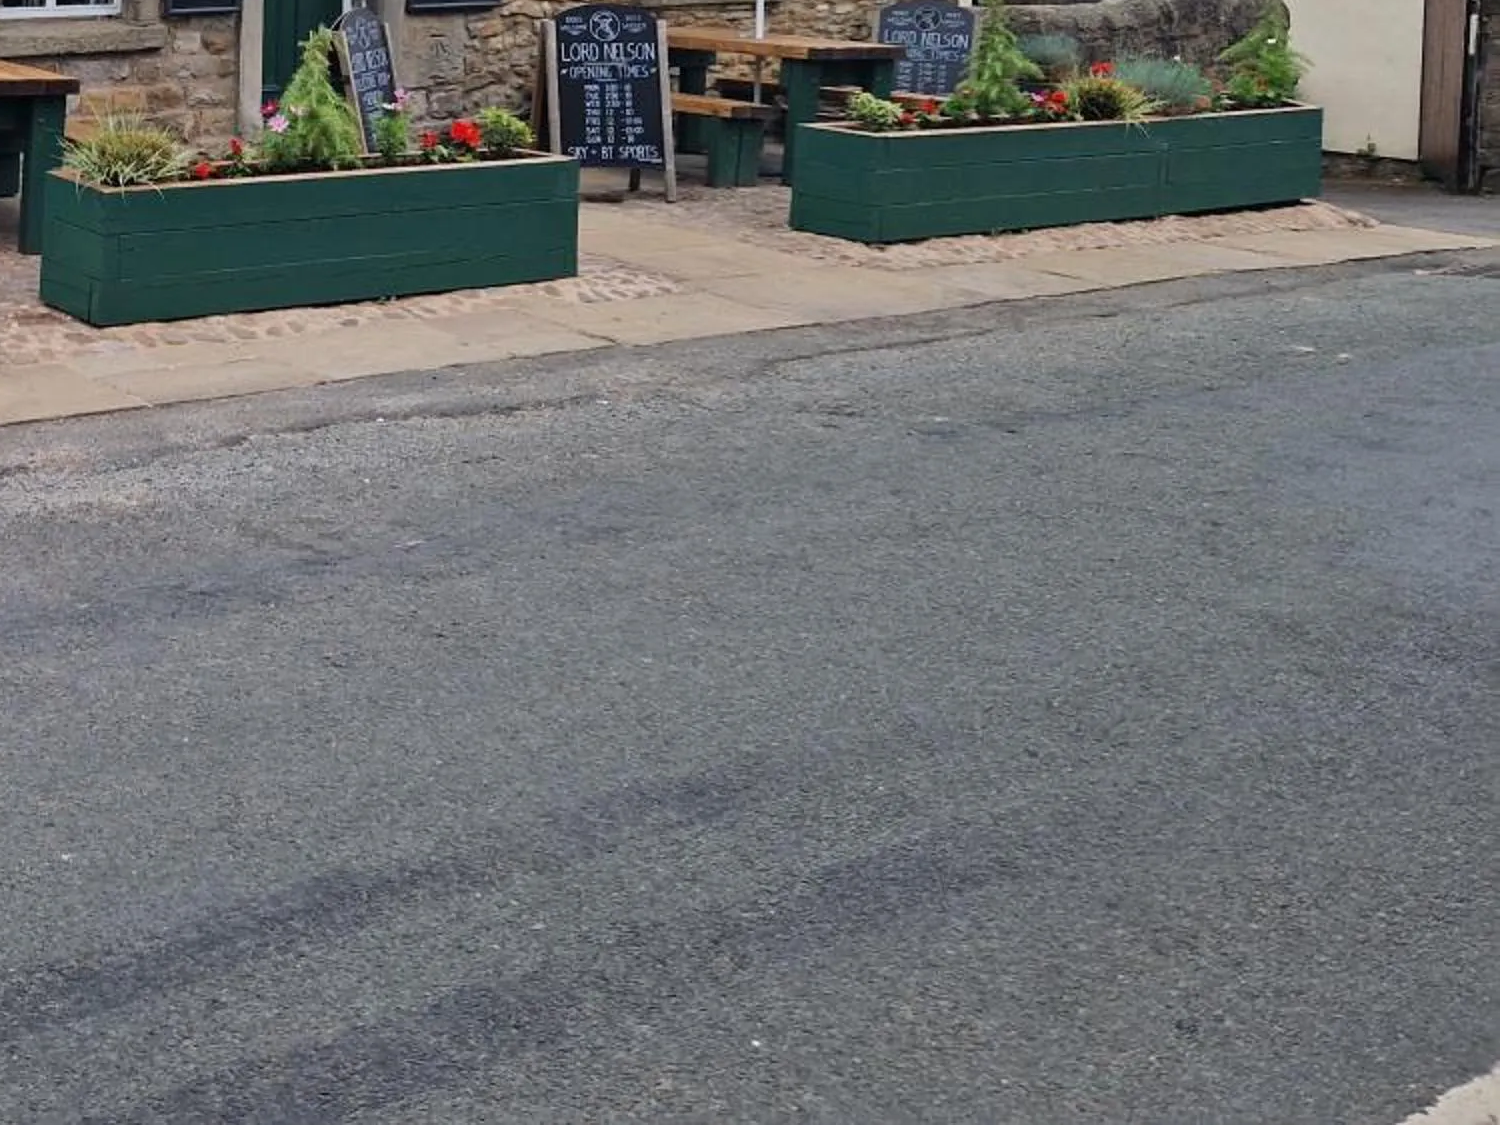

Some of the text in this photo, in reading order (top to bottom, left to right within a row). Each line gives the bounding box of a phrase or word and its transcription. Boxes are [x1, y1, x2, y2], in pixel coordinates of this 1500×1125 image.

[883, 29, 969, 50] LORD NELSON
[561, 41, 656, 63] LORD NELSON
[569, 64, 649, 80] OPENING TIMES
[567, 145, 589, 160] SKY
[601, 145, 615, 160] BT
[619, 145, 659, 160] SPORTS
